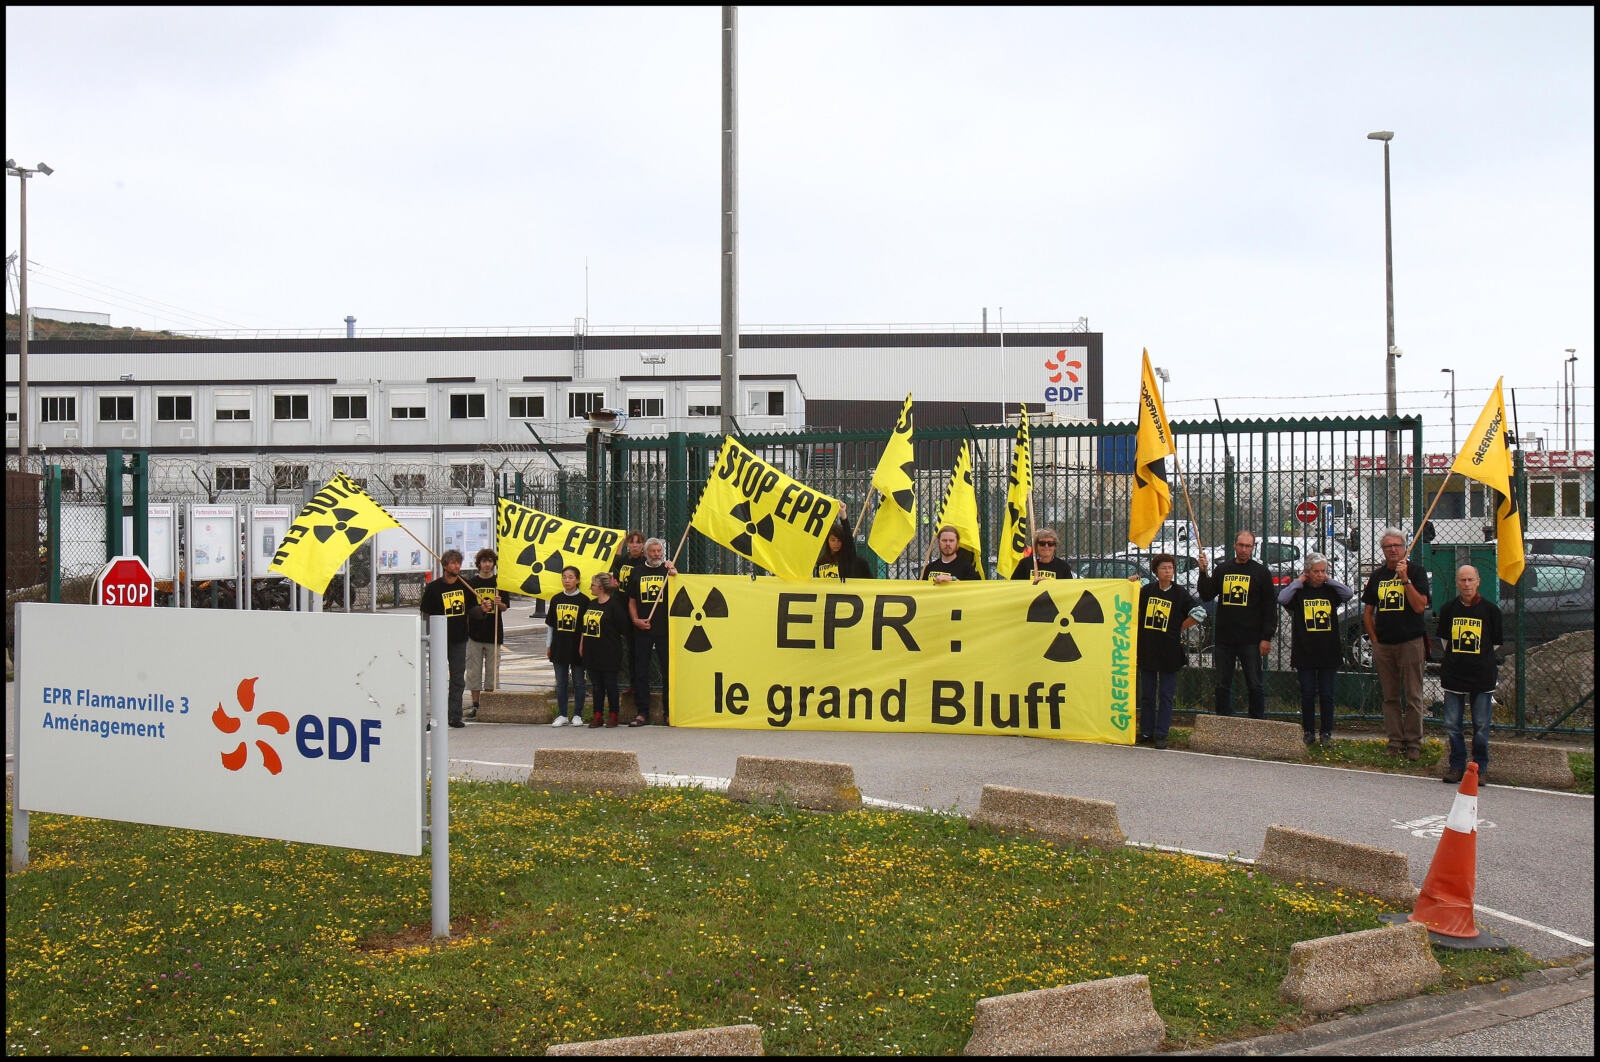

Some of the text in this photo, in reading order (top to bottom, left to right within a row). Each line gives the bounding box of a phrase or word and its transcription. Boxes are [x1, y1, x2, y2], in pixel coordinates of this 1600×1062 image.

[718, 444, 832, 538] STOP EPR
[500, 504, 562, 544] STOP
[562, 526, 618, 562] EPR
[105, 583, 149, 605] STOP
[1148, 598, 1161, 606] STOP
[776, 592, 921, 652] EPR
[1454, 618, 1480, 628] STOP EPR
[1110, 594, 1132, 731] GREENPEACE
[43, 686, 190, 714] EPR Flamanville 3
[714, 672, 1066, 730] le grand Bluff
[42, 712, 166, 738] Aménagement
